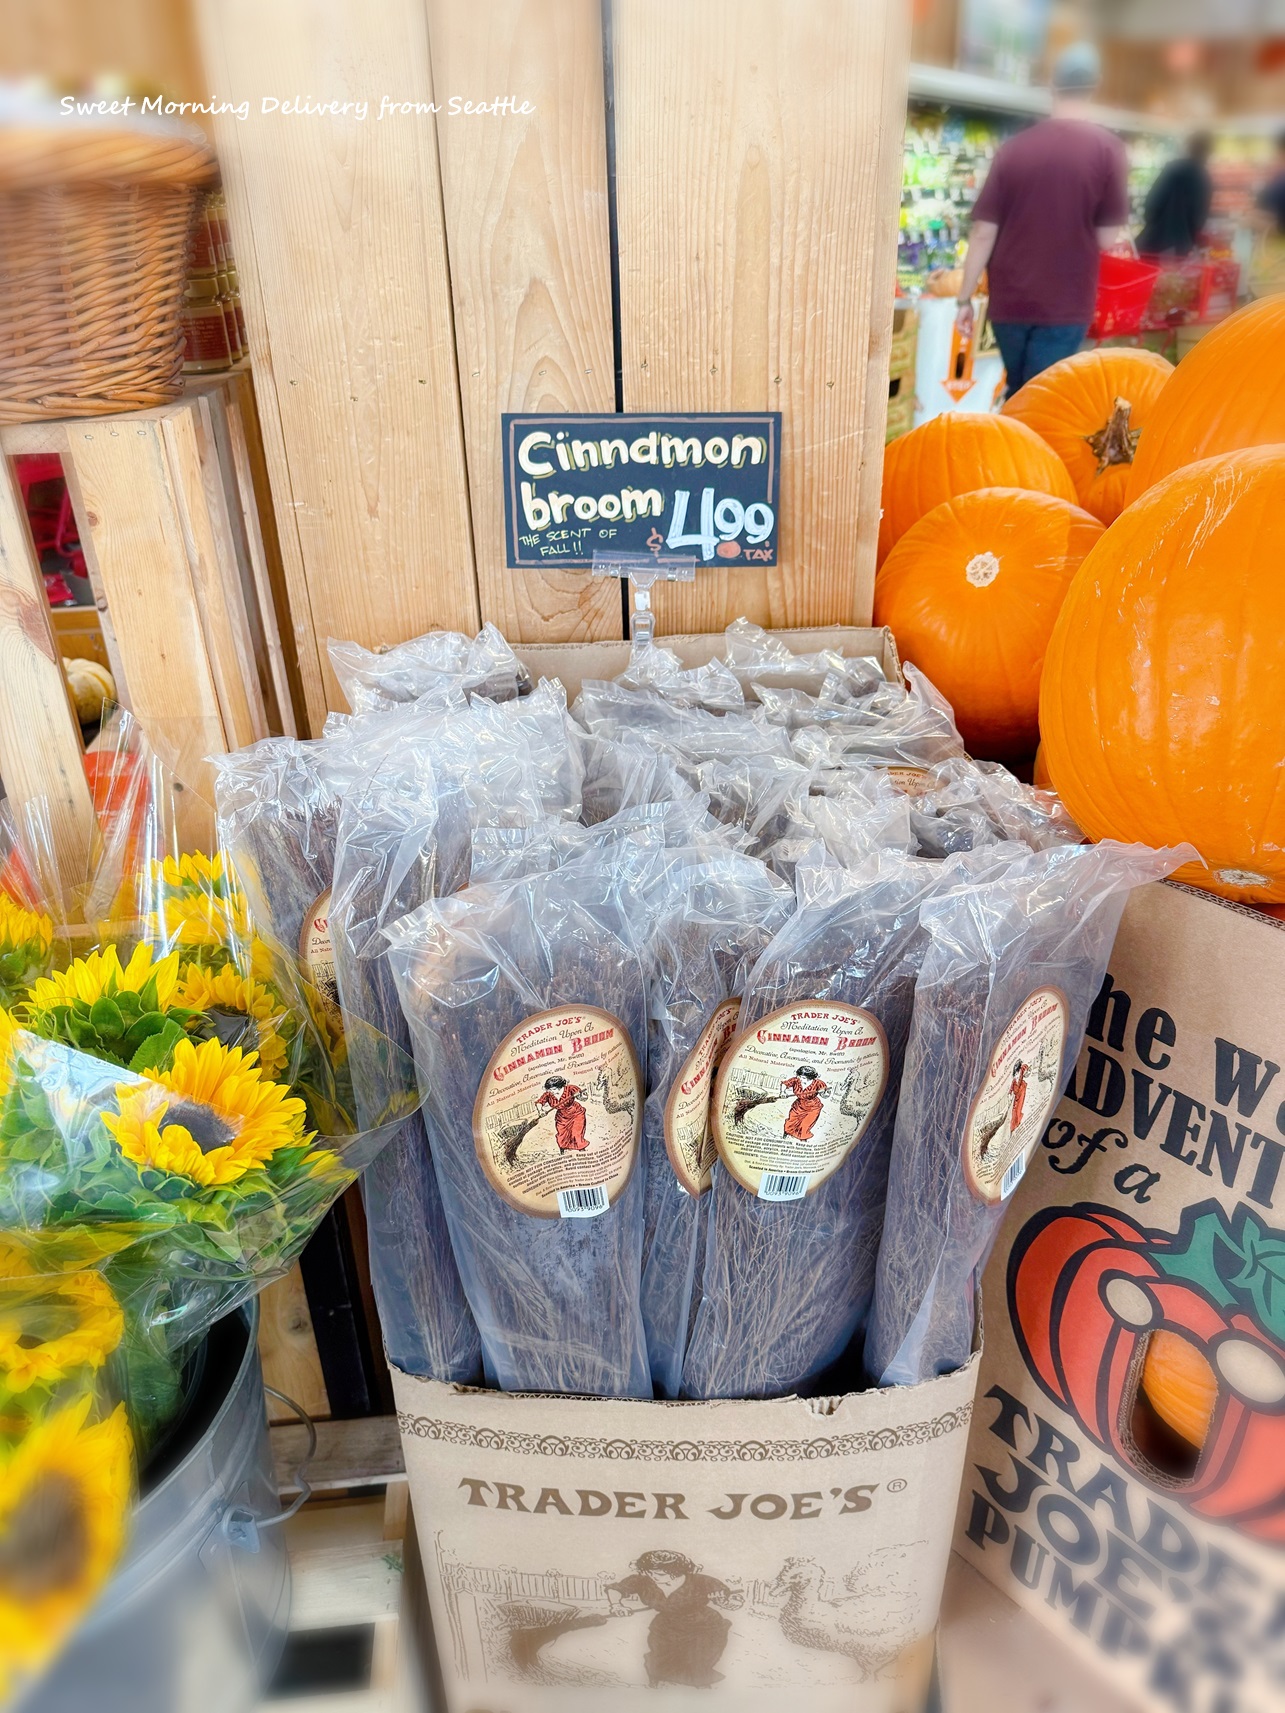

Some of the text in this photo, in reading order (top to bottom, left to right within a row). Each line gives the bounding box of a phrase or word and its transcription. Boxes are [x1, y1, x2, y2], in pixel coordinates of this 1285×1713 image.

[518, 431, 767, 479] Cinnamon
[520, 482, 663, 531] broom
[519, 528, 618, 547] THE SCENT OF
[743, 548, 774, 561] TAX
[516, 1016, 582, 1044] TRADER JOE'S
[780, 1021, 829, 1032] Meditation
[831, 1025, 853, 1036] Upon
[791, 1012, 858, 1025] TRADER JOE'S
[1085, 973, 1176, 1070] he
[493, 1027, 615, 1082] CINNAMON BROOM
[510, 1034, 557, 1057] Meditation
[559, 1028, 582, 1040] Upon
[756, 1029, 829, 1046] CINNAMON
[834, 1036, 877, 1052] BROOM
[991, 1026, 1027, 1078] CINNAMON
[554, 1064, 566, 1074] and
[567, 1056, 600, 1070] Romantic
[600, 1050, 608, 1060] by
[749, 1055, 768, 1064] Natural
[770, 1060, 795, 1068] Materials
[824, 1057, 856, 1065] Romantic
[856, 1055, 862, 1063] by
[496, 1092, 516, 1104] Natural
[516, 1081, 541, 1094] Materials
[1041, 1117, 1128, 1175] of
[1114, 1163, 1161, 1204] a
[457, 1477, 690, 1520] TRADER
[706, 1483, 881, 1521] JOE'S
